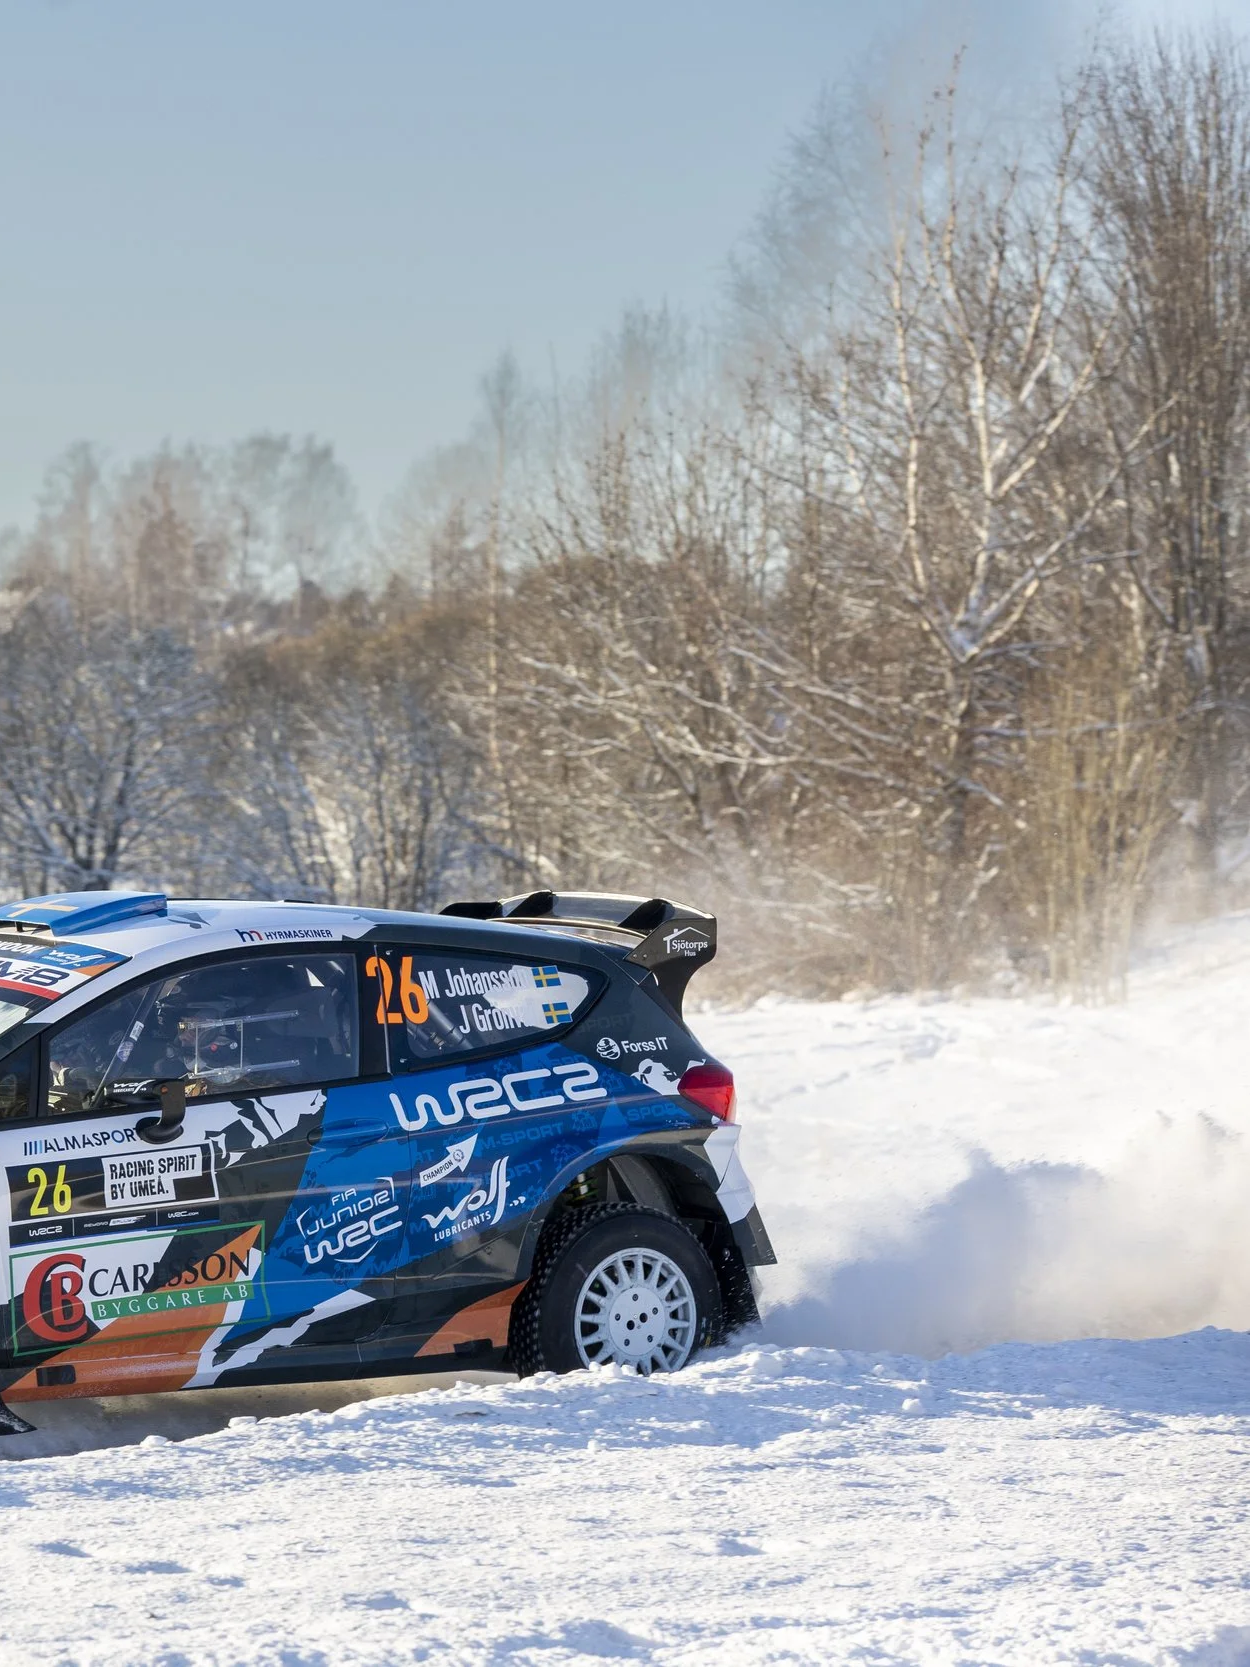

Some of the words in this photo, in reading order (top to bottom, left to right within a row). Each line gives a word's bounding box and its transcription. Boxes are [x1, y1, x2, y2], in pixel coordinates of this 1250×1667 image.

[264, 929, 333, 941] HYRMASKINER
[672, 939, 708, 953] Sjötorps
[684, 949, 696, 957] Hus
[365, 956, 429, 1025] 26
[418, 970, 440, 1000] M
[459, 1004, 471, 1034] J
[621, 1040, 656, 1054] Forss
[656, 1037, 669, 1050] IT
[390, 1062, 608, 1132] WRC2
[44, 1127, 139, 1154] ALMASPOR
[110, 1157, 154, 1180] RACING
[157, 1153, 197, 1174] SPIRIT
[422, 1160, 454, 1182] CHAMPION
[27, 1164, 72, 1217] 26
[111, 1182, 126, 1201] BY
[331, 1187, 357, 1206] FIA
[306, 1190, 391, 1236] JUNIOR
[434, 1210, 492, 1242] LUBRICANTS
[28, 1225, 63, 1237] WRC2
[304, 1205, 403, 1264] WRC
[96, 1289, 206, 1319] BYGGARE
[222, 1283, 249, 1301] AB
